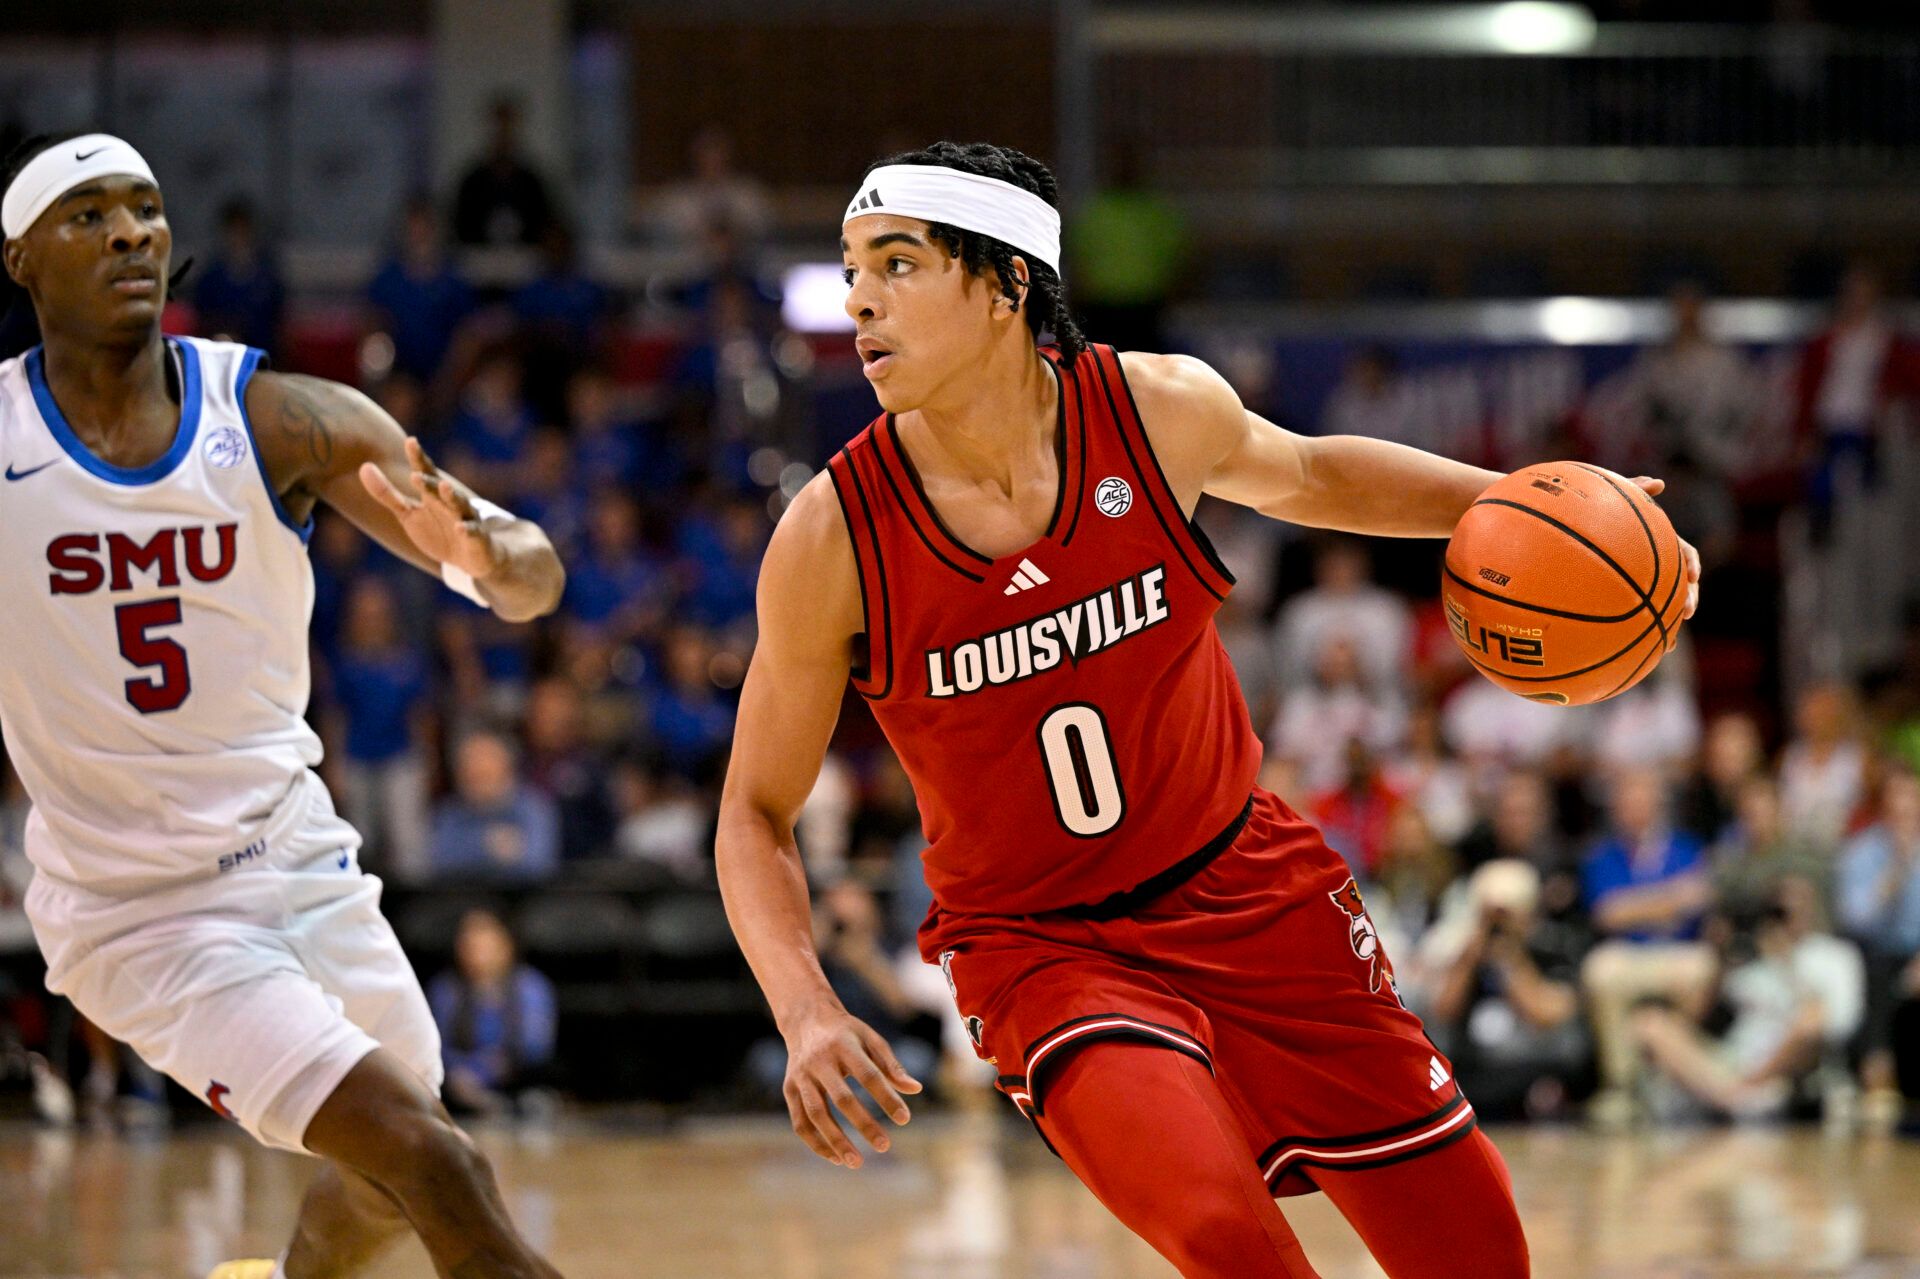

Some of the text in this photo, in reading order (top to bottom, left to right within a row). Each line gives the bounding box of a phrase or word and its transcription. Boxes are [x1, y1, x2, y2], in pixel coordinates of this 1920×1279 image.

[1101, 486, 1127, 502] ACC
[46, 521, 238, 594] SMU
[114, 596, 191, 714] 5
[925, 562, 1171, 698] LOUISVILLE
[1445, 599, 1545, 668] ELITE
[1036, 701, 1127, 839] 0
[218, 838, 267, 872] SMU
